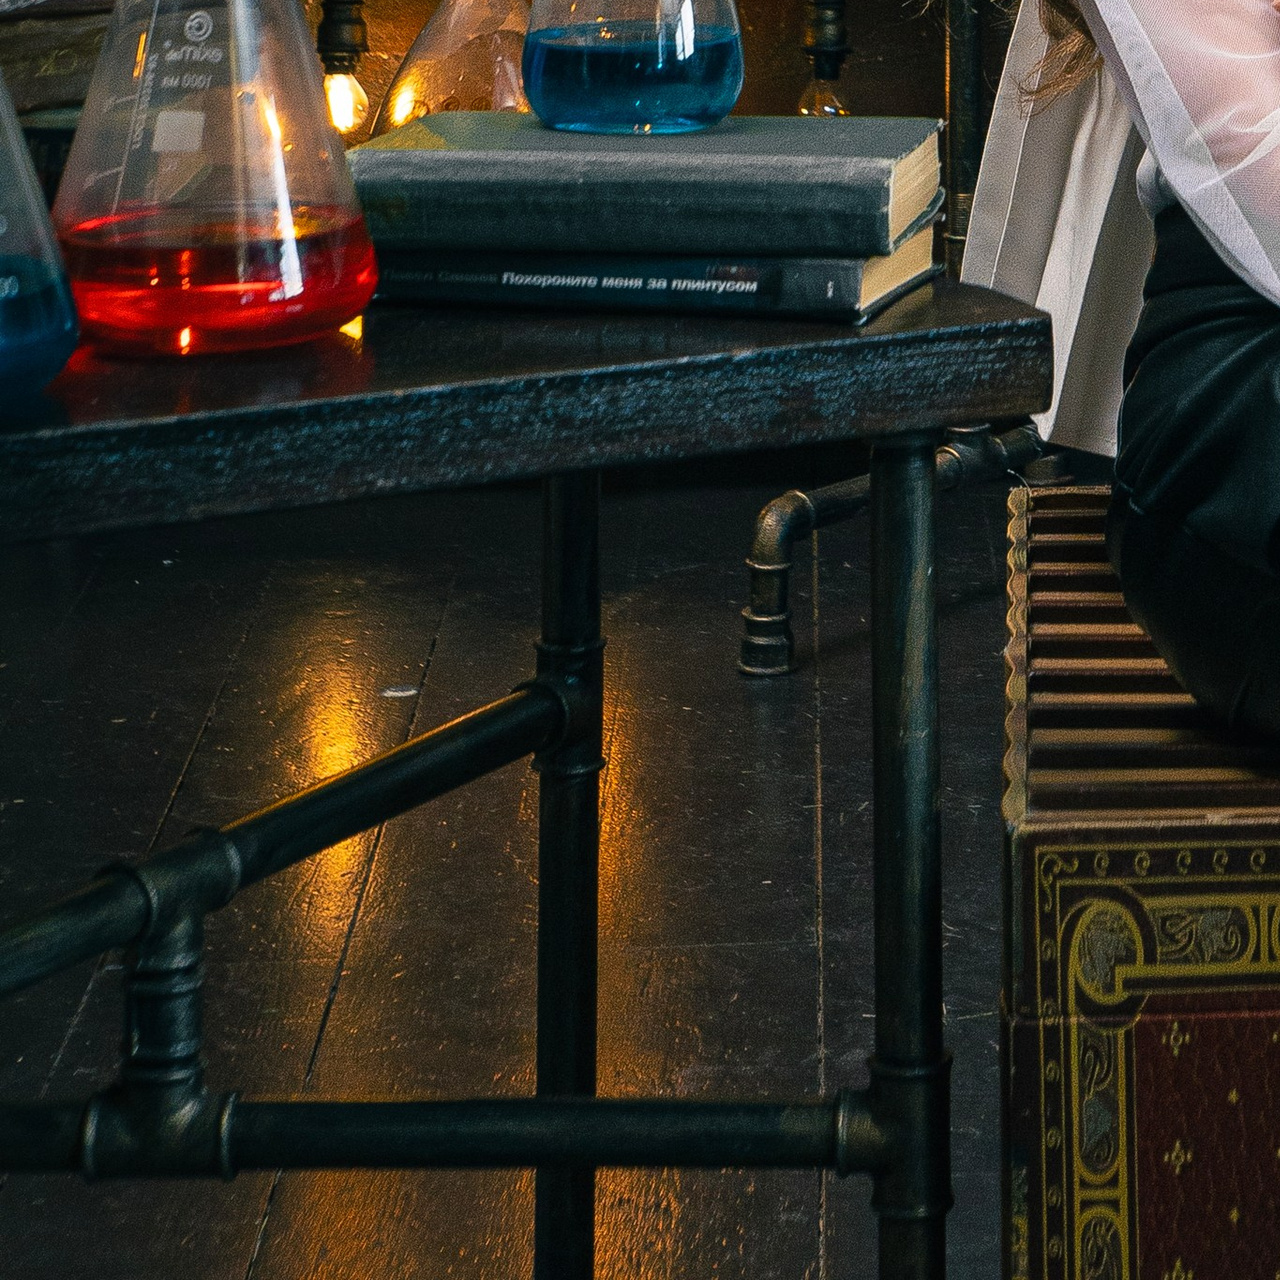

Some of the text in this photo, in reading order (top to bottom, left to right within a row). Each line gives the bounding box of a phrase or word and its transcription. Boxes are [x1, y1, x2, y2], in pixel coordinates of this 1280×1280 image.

[502, 271, 598, 289] Похороните
[601, 277, 644, 290] меня
[646, 278, 668, 291] за
[671, 277, 758, 294] плинтусом
